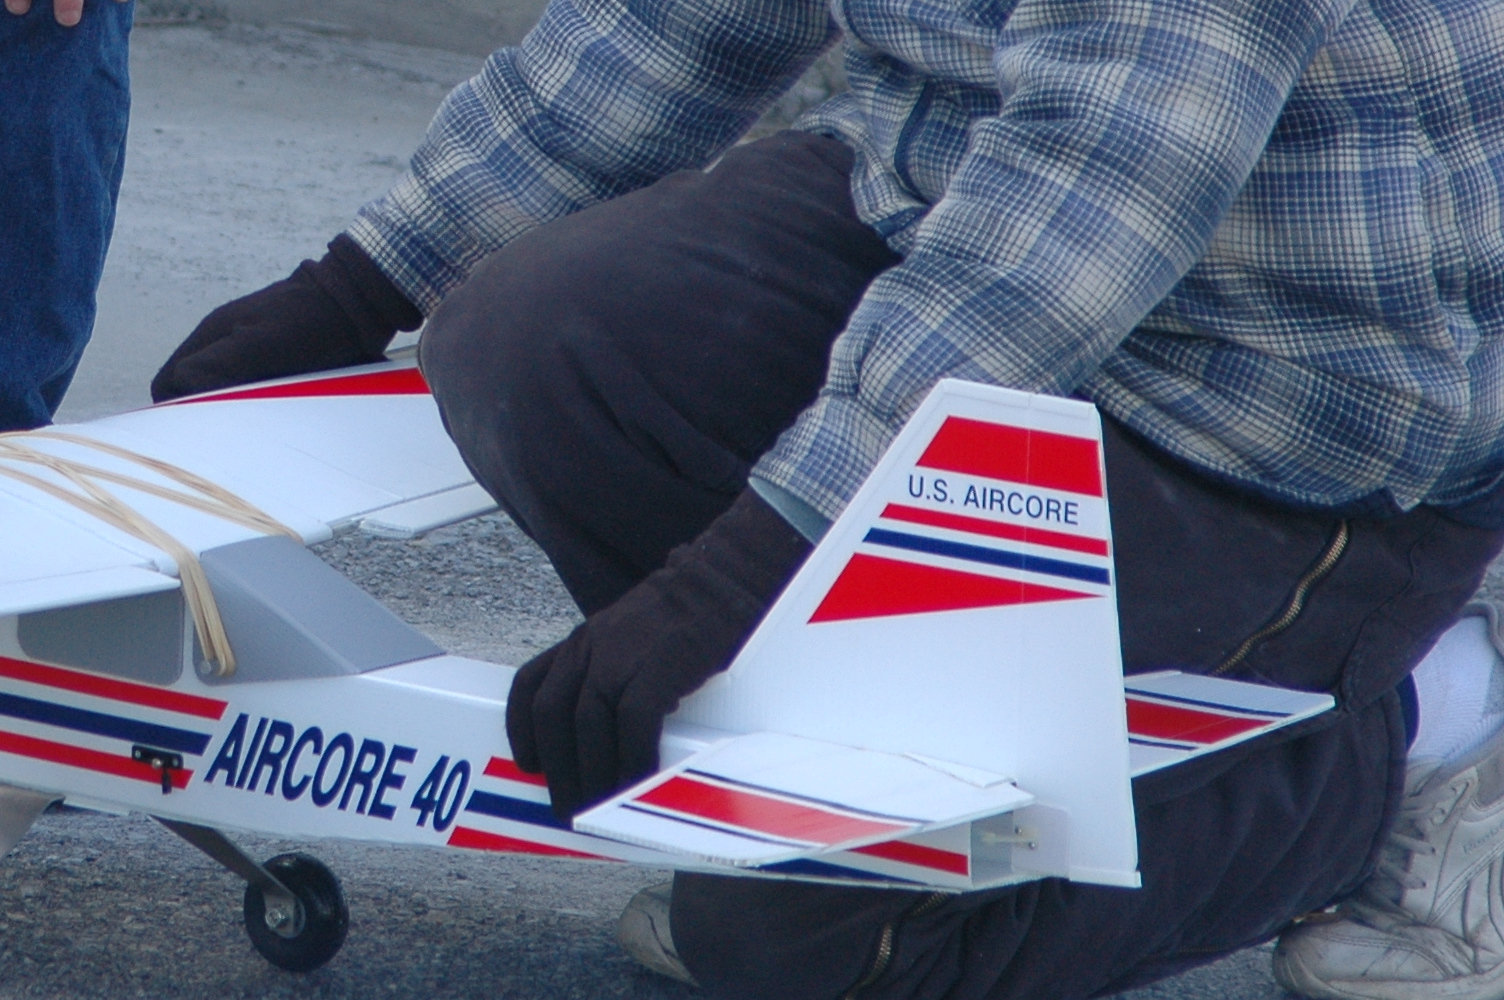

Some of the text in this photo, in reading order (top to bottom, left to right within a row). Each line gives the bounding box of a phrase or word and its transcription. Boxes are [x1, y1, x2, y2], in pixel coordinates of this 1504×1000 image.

[908, 474, 1079, 526] U.S. AIRCORE
[203, 712, 472, 833] AIRCORE 40
